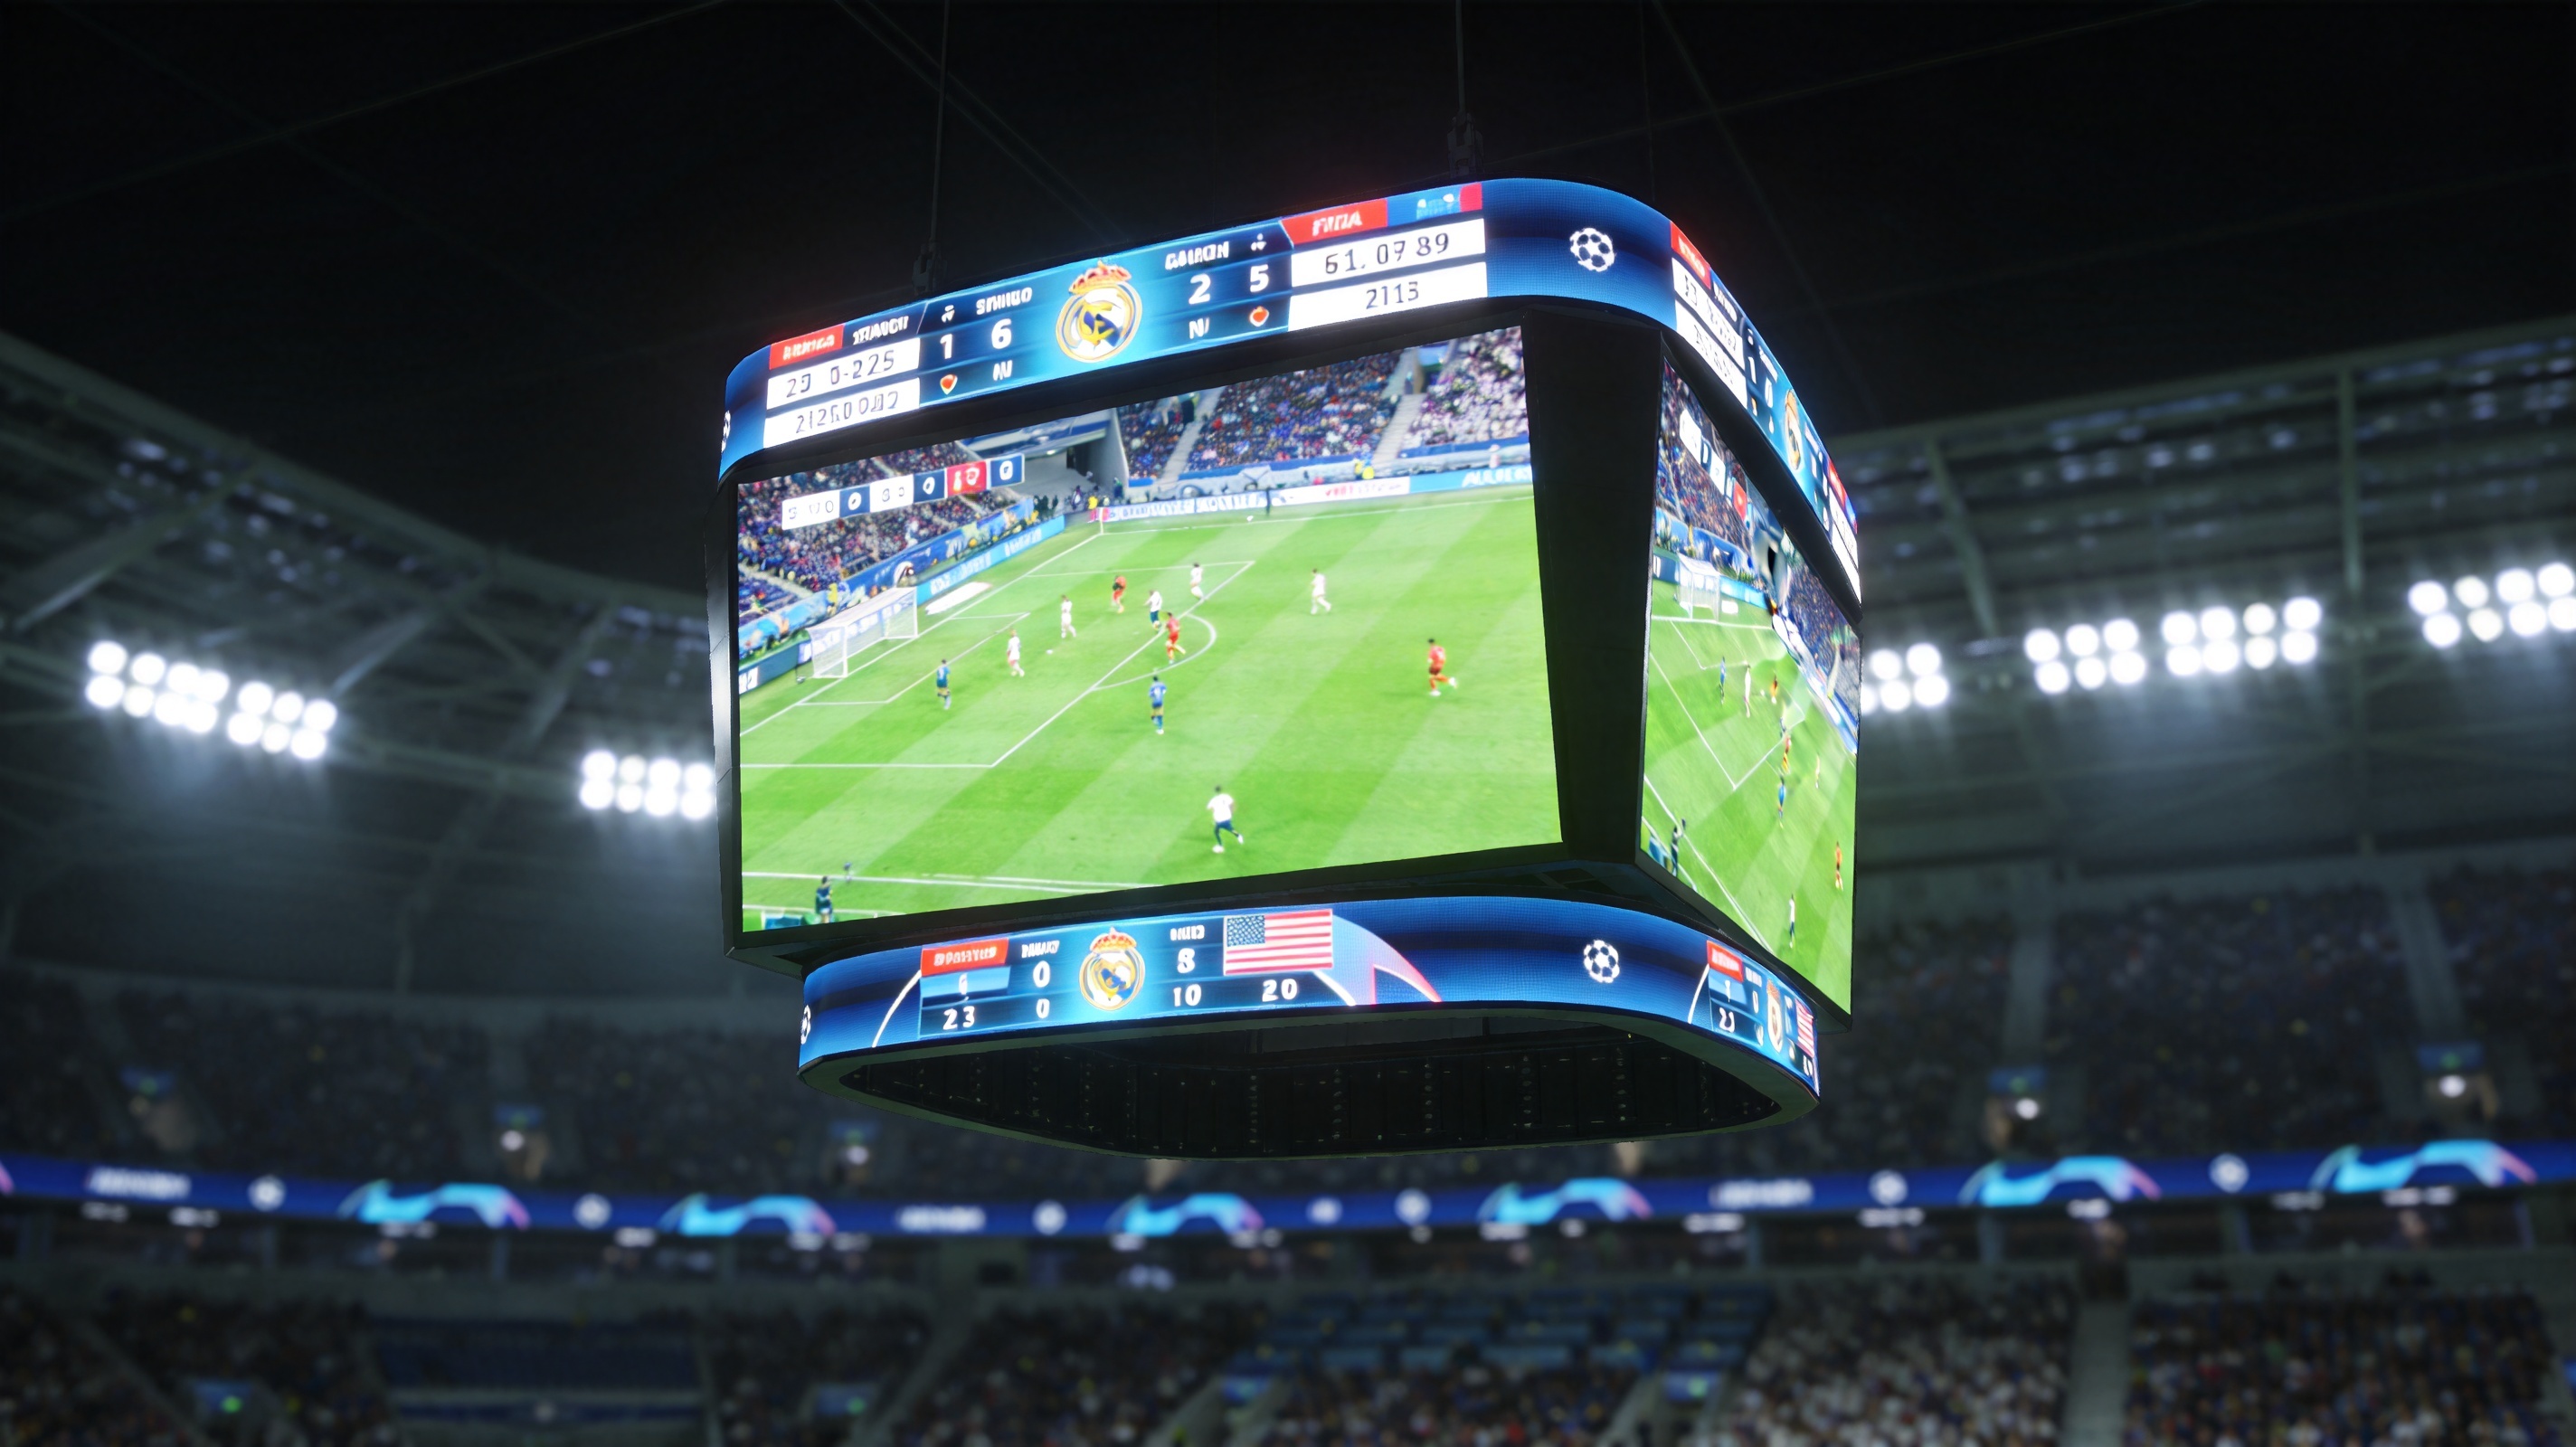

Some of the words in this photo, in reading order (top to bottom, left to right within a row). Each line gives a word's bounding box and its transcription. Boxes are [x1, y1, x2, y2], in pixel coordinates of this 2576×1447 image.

[1189, 273, 1211, 304] 2
[1249, 264, 1269, 292] 5
[1366, 281, 1419, 309] 2113
[940, 334, 952, 359] 1
[991, 318, 1012, 350] 6
[1033, 960, 1050, 988] 0
[942, 1006, 975, 1030] 23
[1036, 998, 1050, 1018] 0
[1173, 983, 1202, 1007] 10
[1262, 978, 1298, 1002] 20
